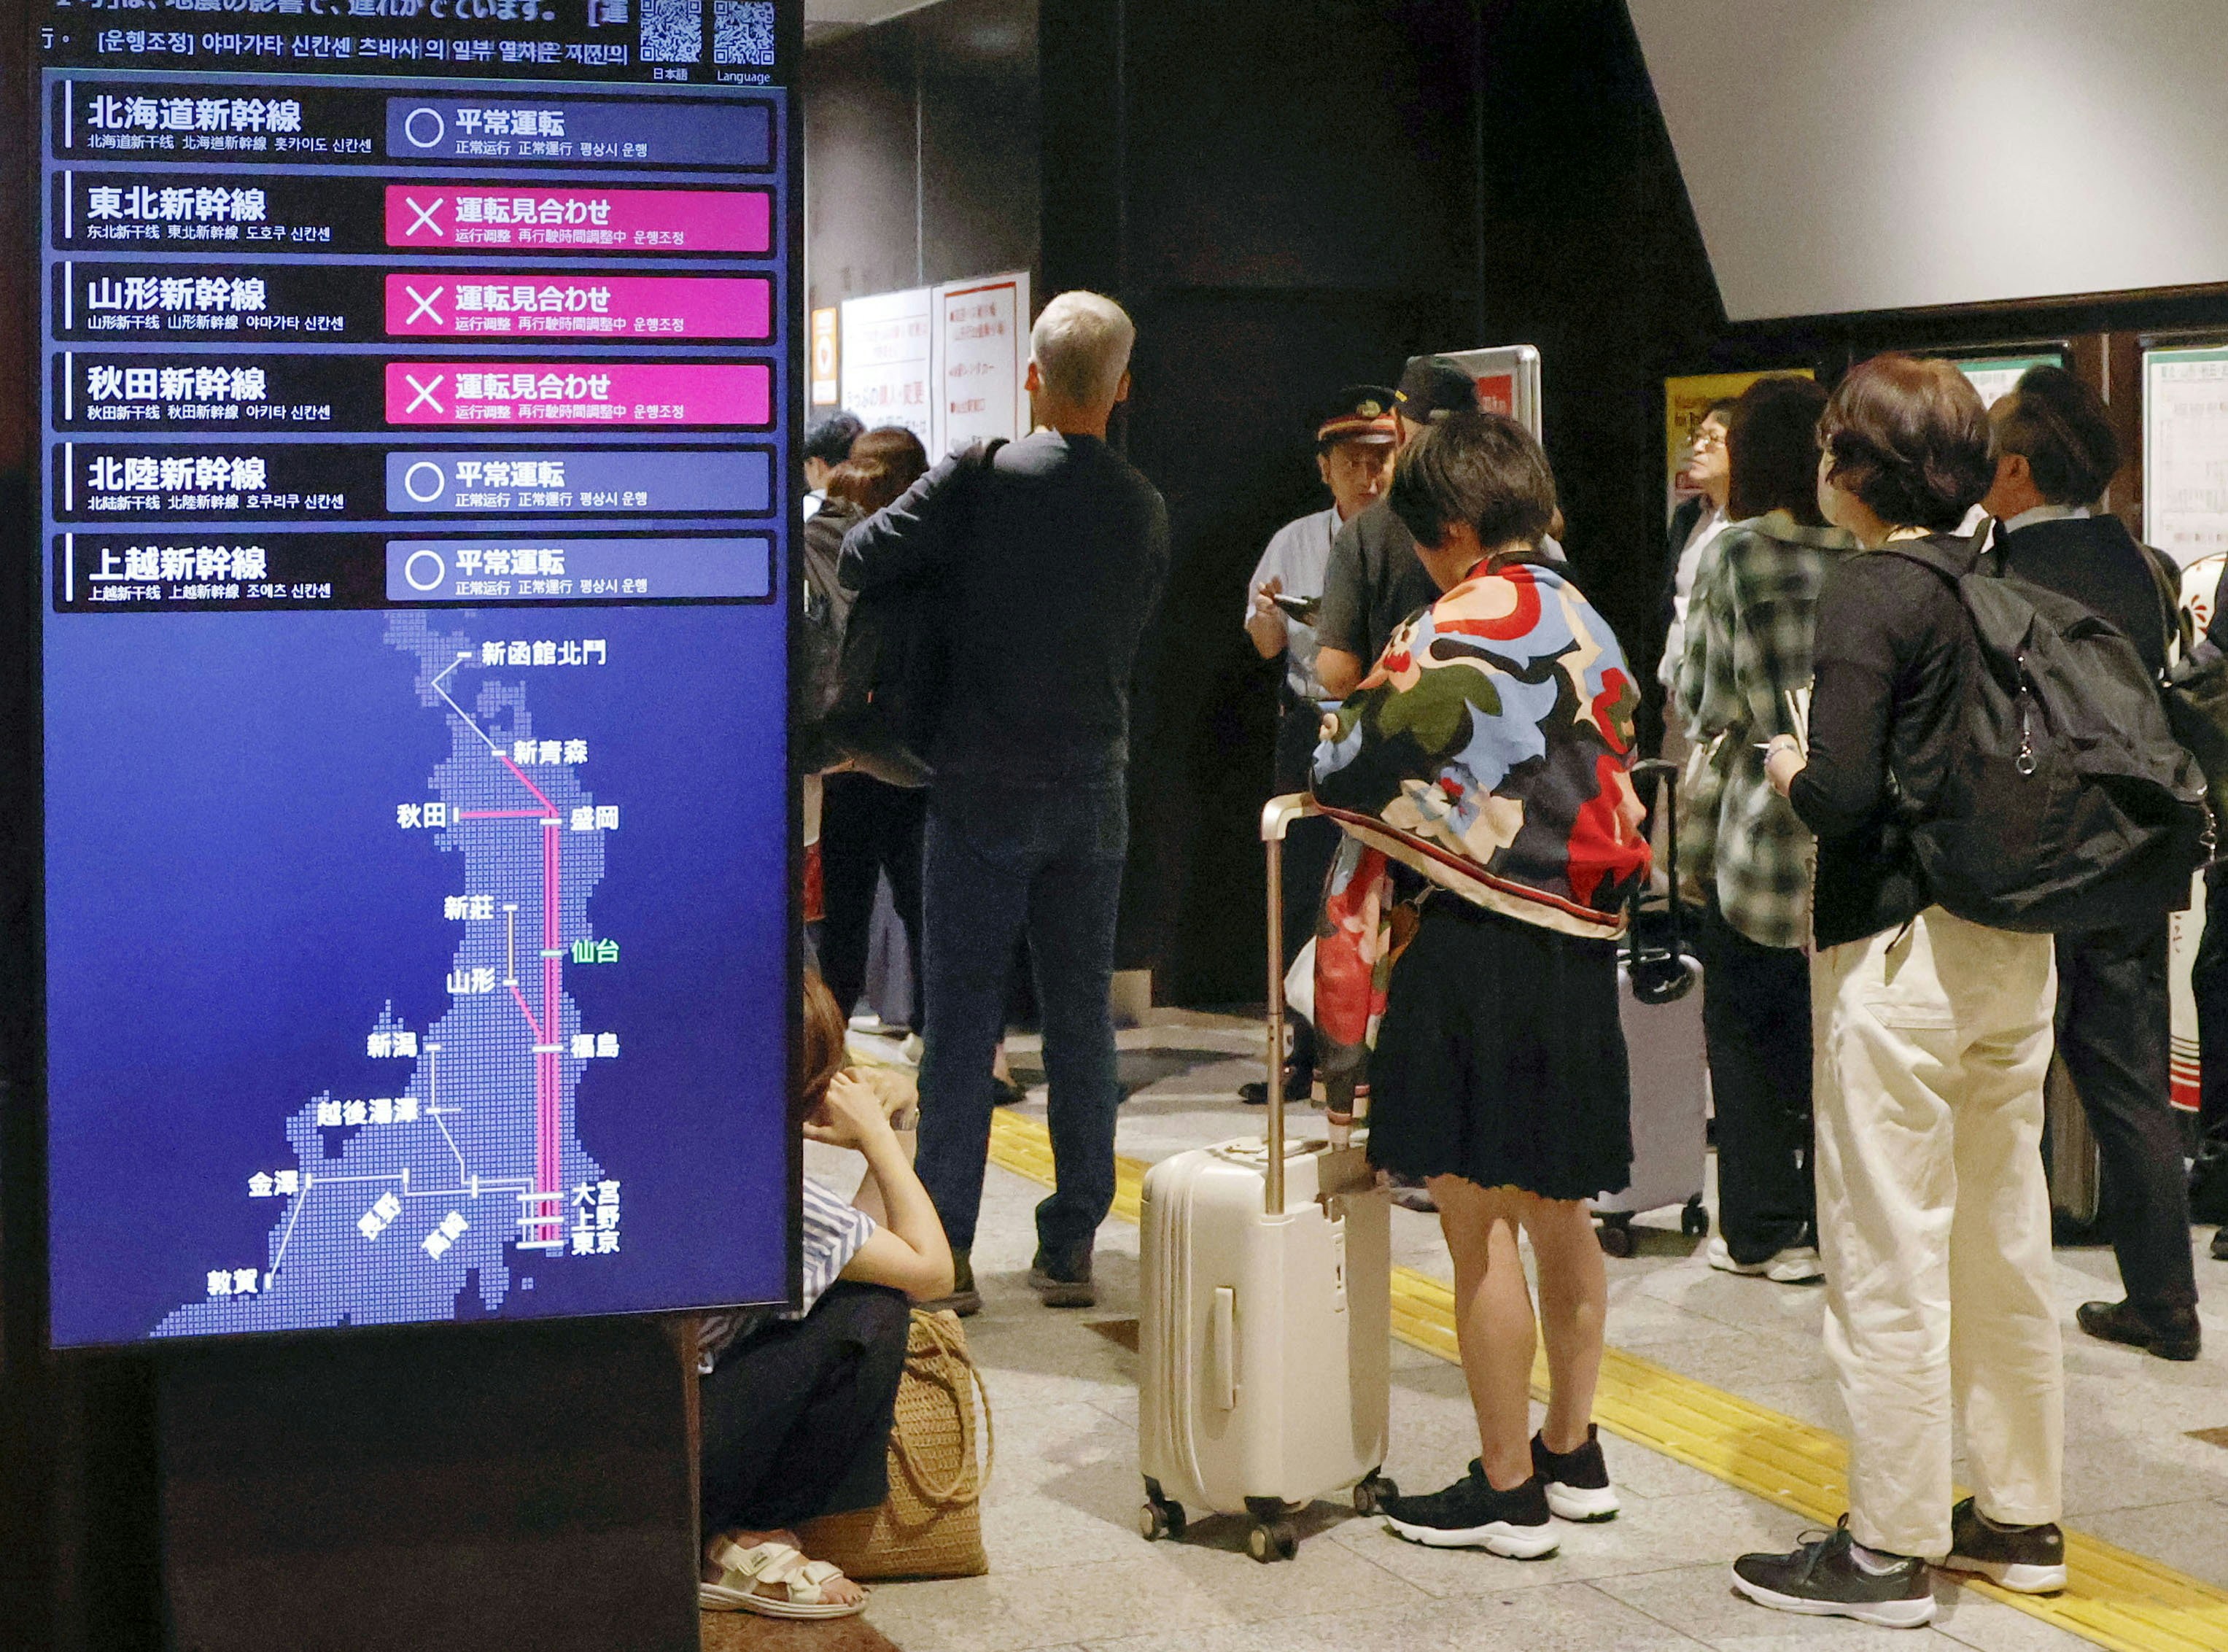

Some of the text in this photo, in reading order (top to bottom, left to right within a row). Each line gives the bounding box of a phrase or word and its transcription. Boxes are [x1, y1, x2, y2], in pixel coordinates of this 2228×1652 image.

[98, 29, 194, 55] [운행조정]
[202, 31, 284, 56] 야마가타
[291, 35, 350, 58] 신칸센
[358, 37, 419, 60] 츠바사
[452, 40, 496, 61] 일부
[653, 67, 688, 81] 日本語
[717, 70, 771, 85] Language
[88, 95, 301, 133] 北海道新幹線
[455, 109, 565, 137] 平常運転
[87, 133, 175, 150] 北海道新干线
[182, 134, 267, 151] 北海道新幹線
[332, 138, 372, 153] 신칸센
[455, 140, 648, 158] 正常运行 正常運行 평상시 운행
[87, 185, 266, 222] 東北新幹線
[455, 196, 611, 225] 運転見合わせ
[87, 224, 330, 241] 东北新干线 東北新幹線 도호쿠 신칸센
[454, 228, 684, 246] 运行调整 再行駛時間調整中 운행조정
[88, 276, 266, 311] 山形新幹線
[455, 284, 611, 313] 運転見合わせ
[88, 314, 343, 331] 山形新干线 山形新幹線 야마가타 신칸센
[454, 316, 684, 333] 运行调整 再行駛時間調整中 운행조정
[87, 365, 266, 401] 秋田新幹線
[455, 373, 611, 400] 運転見合わせ
[87, 404, 330, 420] 秋田新干线 秋田新幹線 아키타 신칸센
[455, 403, 684, 419] 运行调整 再行駛時間調整中 운행조정
[88, 456, 267, 492] 北陸新幹線
[455, 460, 565, 488] 平常運転
[87, 493, 344, 511] 北陆新干线 北陸新幹線 호쿠리쿠 신칸센
[454, 491, 648, 508] 正常运行 正常運行 평상시 운행
[89, 546, 268, 581] 上越新幹線
[455, 548, 565, 576] 平常運転
[88, 583, 331, 602] 上越新干线 上越新幹線 조에츠 신칸센
[455, 578, 648, 596] 正常运行 正常運行 평상시 운행
[513, 739, 588, 765] 新青森
[397, 802, 446, 829] 秋田
[570, 805, 618, 831] 盛岡
[570, 936, 619, 963] 仙台
[446, 967, 496, 994] 山形
[570, 1032, 620, 1059] 福島
[571, 1179, 620, 1206] 大宮
[571, 1205, 620, 1232] 上野
[571, 1230, 620, 1256] 東京
[207, 1268, 258, 1295] 敦賀
